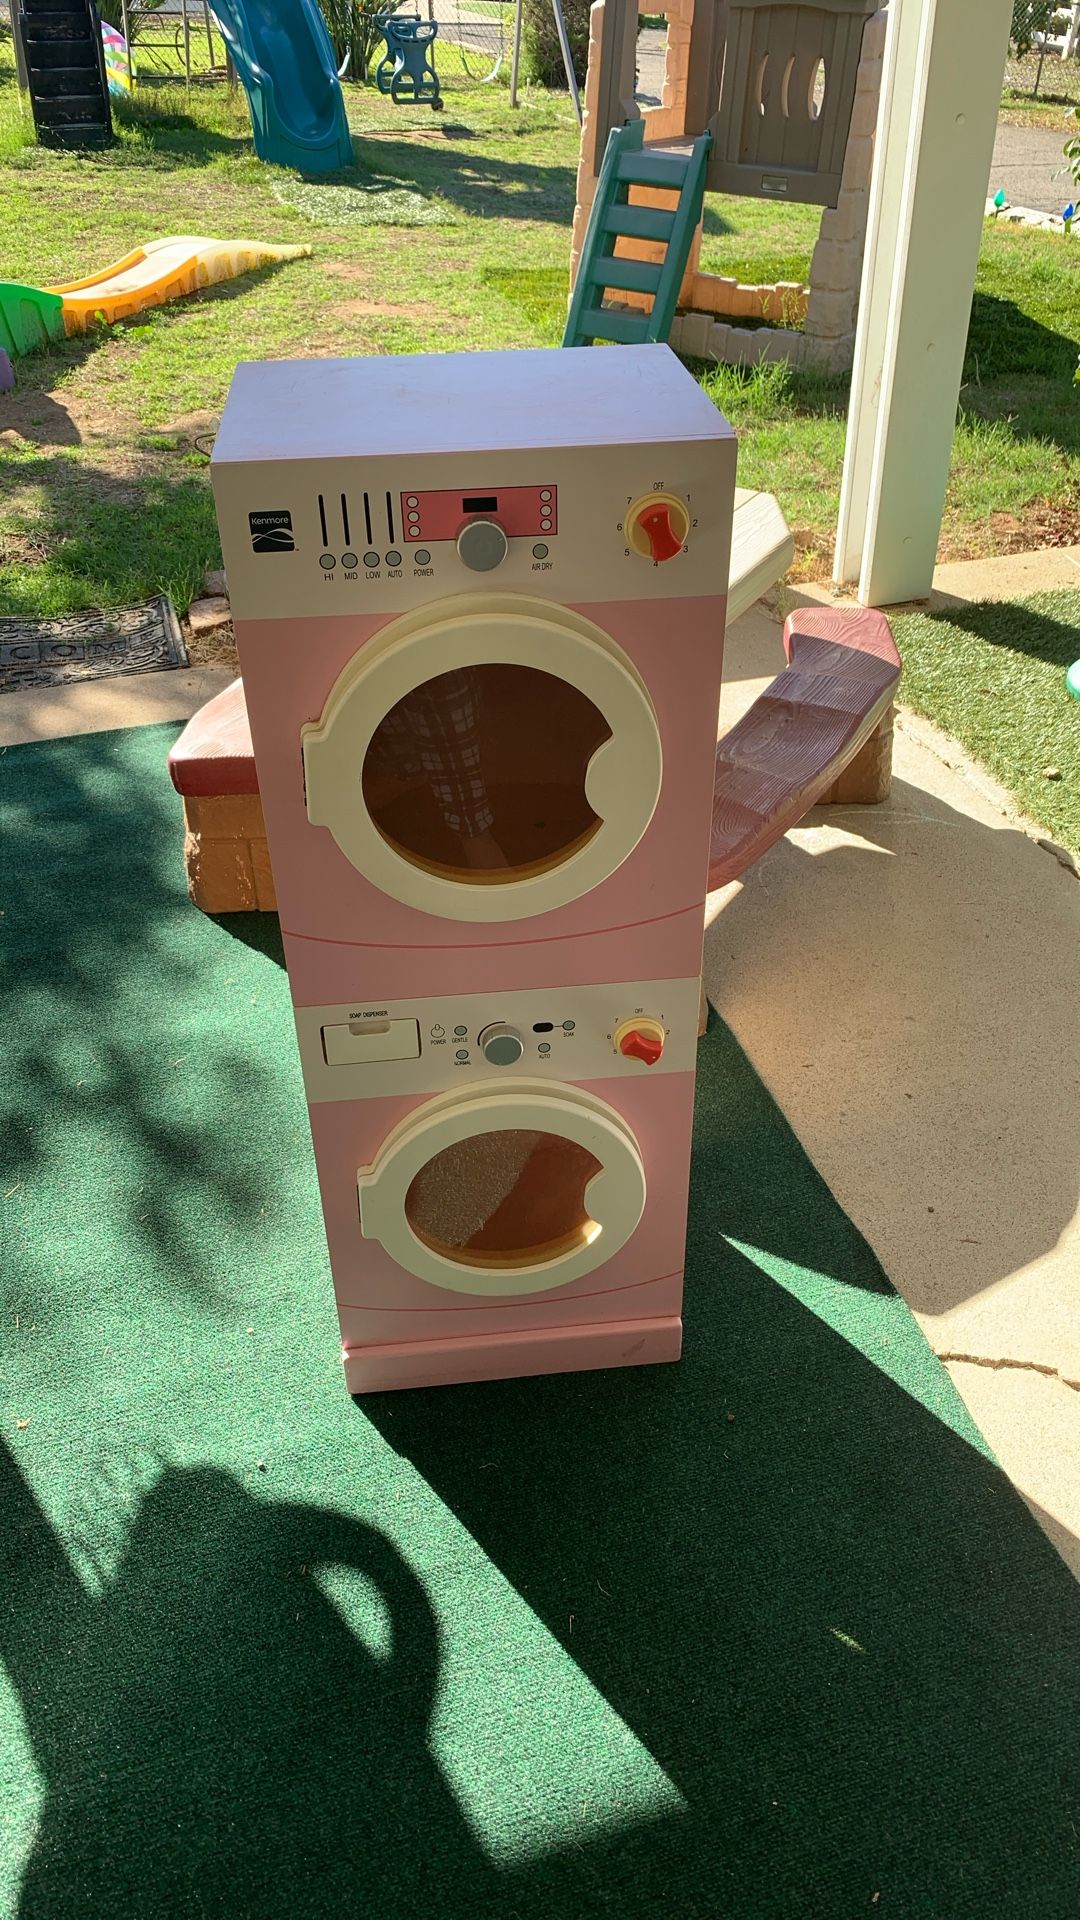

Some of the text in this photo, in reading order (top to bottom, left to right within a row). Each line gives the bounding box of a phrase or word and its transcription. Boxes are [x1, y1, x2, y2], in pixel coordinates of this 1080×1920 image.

[653, 482, 665, 490] OFF
[627, 497, 632, 505] 7
[686, 494, 691, 502] 1
[251, 516, 289, 525] Kenmore
[692, 519, 698, 528] 2
[616, 523, 623, 531] 6
[624, 548, 630, 557] 5
[683, 545, 689, 553] 3
[531, 562, 553, 571] AIR DRY
[324, 568, 434, 581] HI MID LOW AUTO POWER
[362, 1010, 389, 1018] DISPENSER
